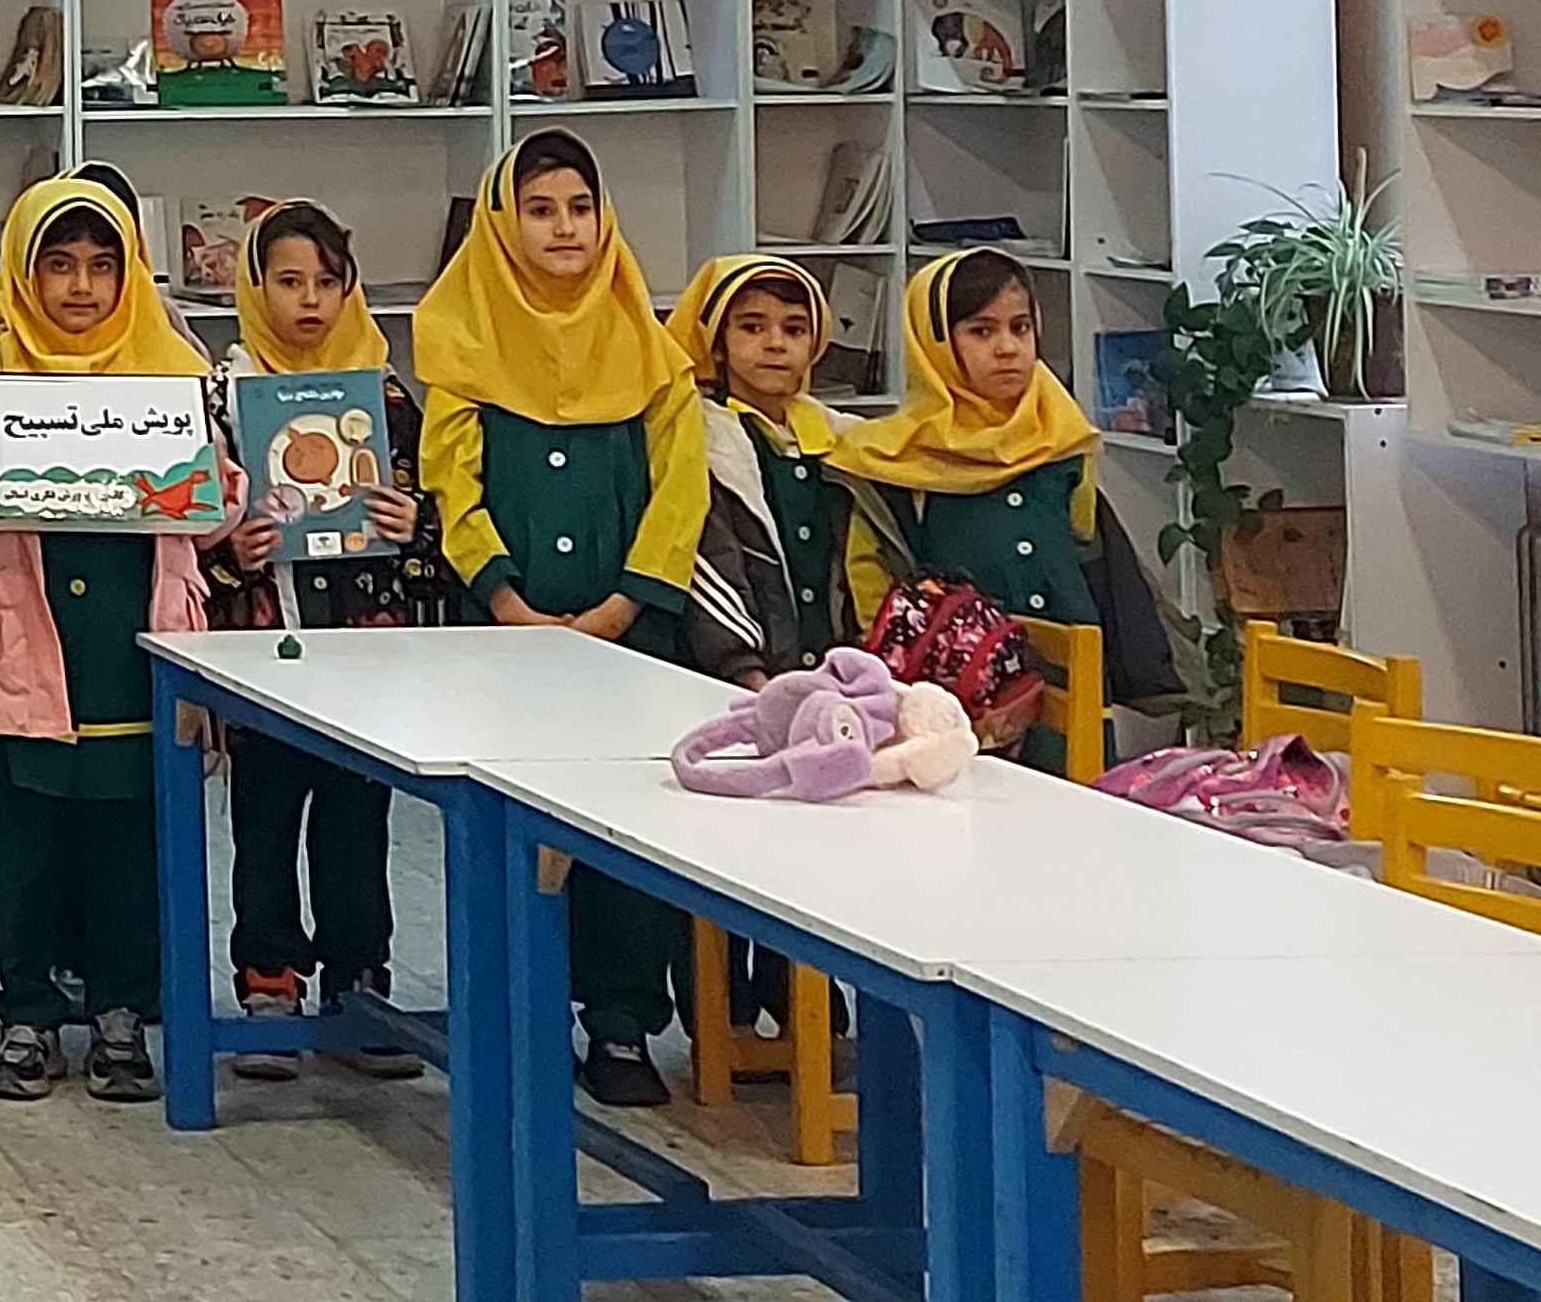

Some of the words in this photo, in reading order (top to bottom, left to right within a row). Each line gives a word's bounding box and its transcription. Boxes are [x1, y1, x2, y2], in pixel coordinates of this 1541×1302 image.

[3, 405, 78, 438] تسبیح
[81, 408, 124, 436] ملی
[132, 407, 193, 436] پویش
